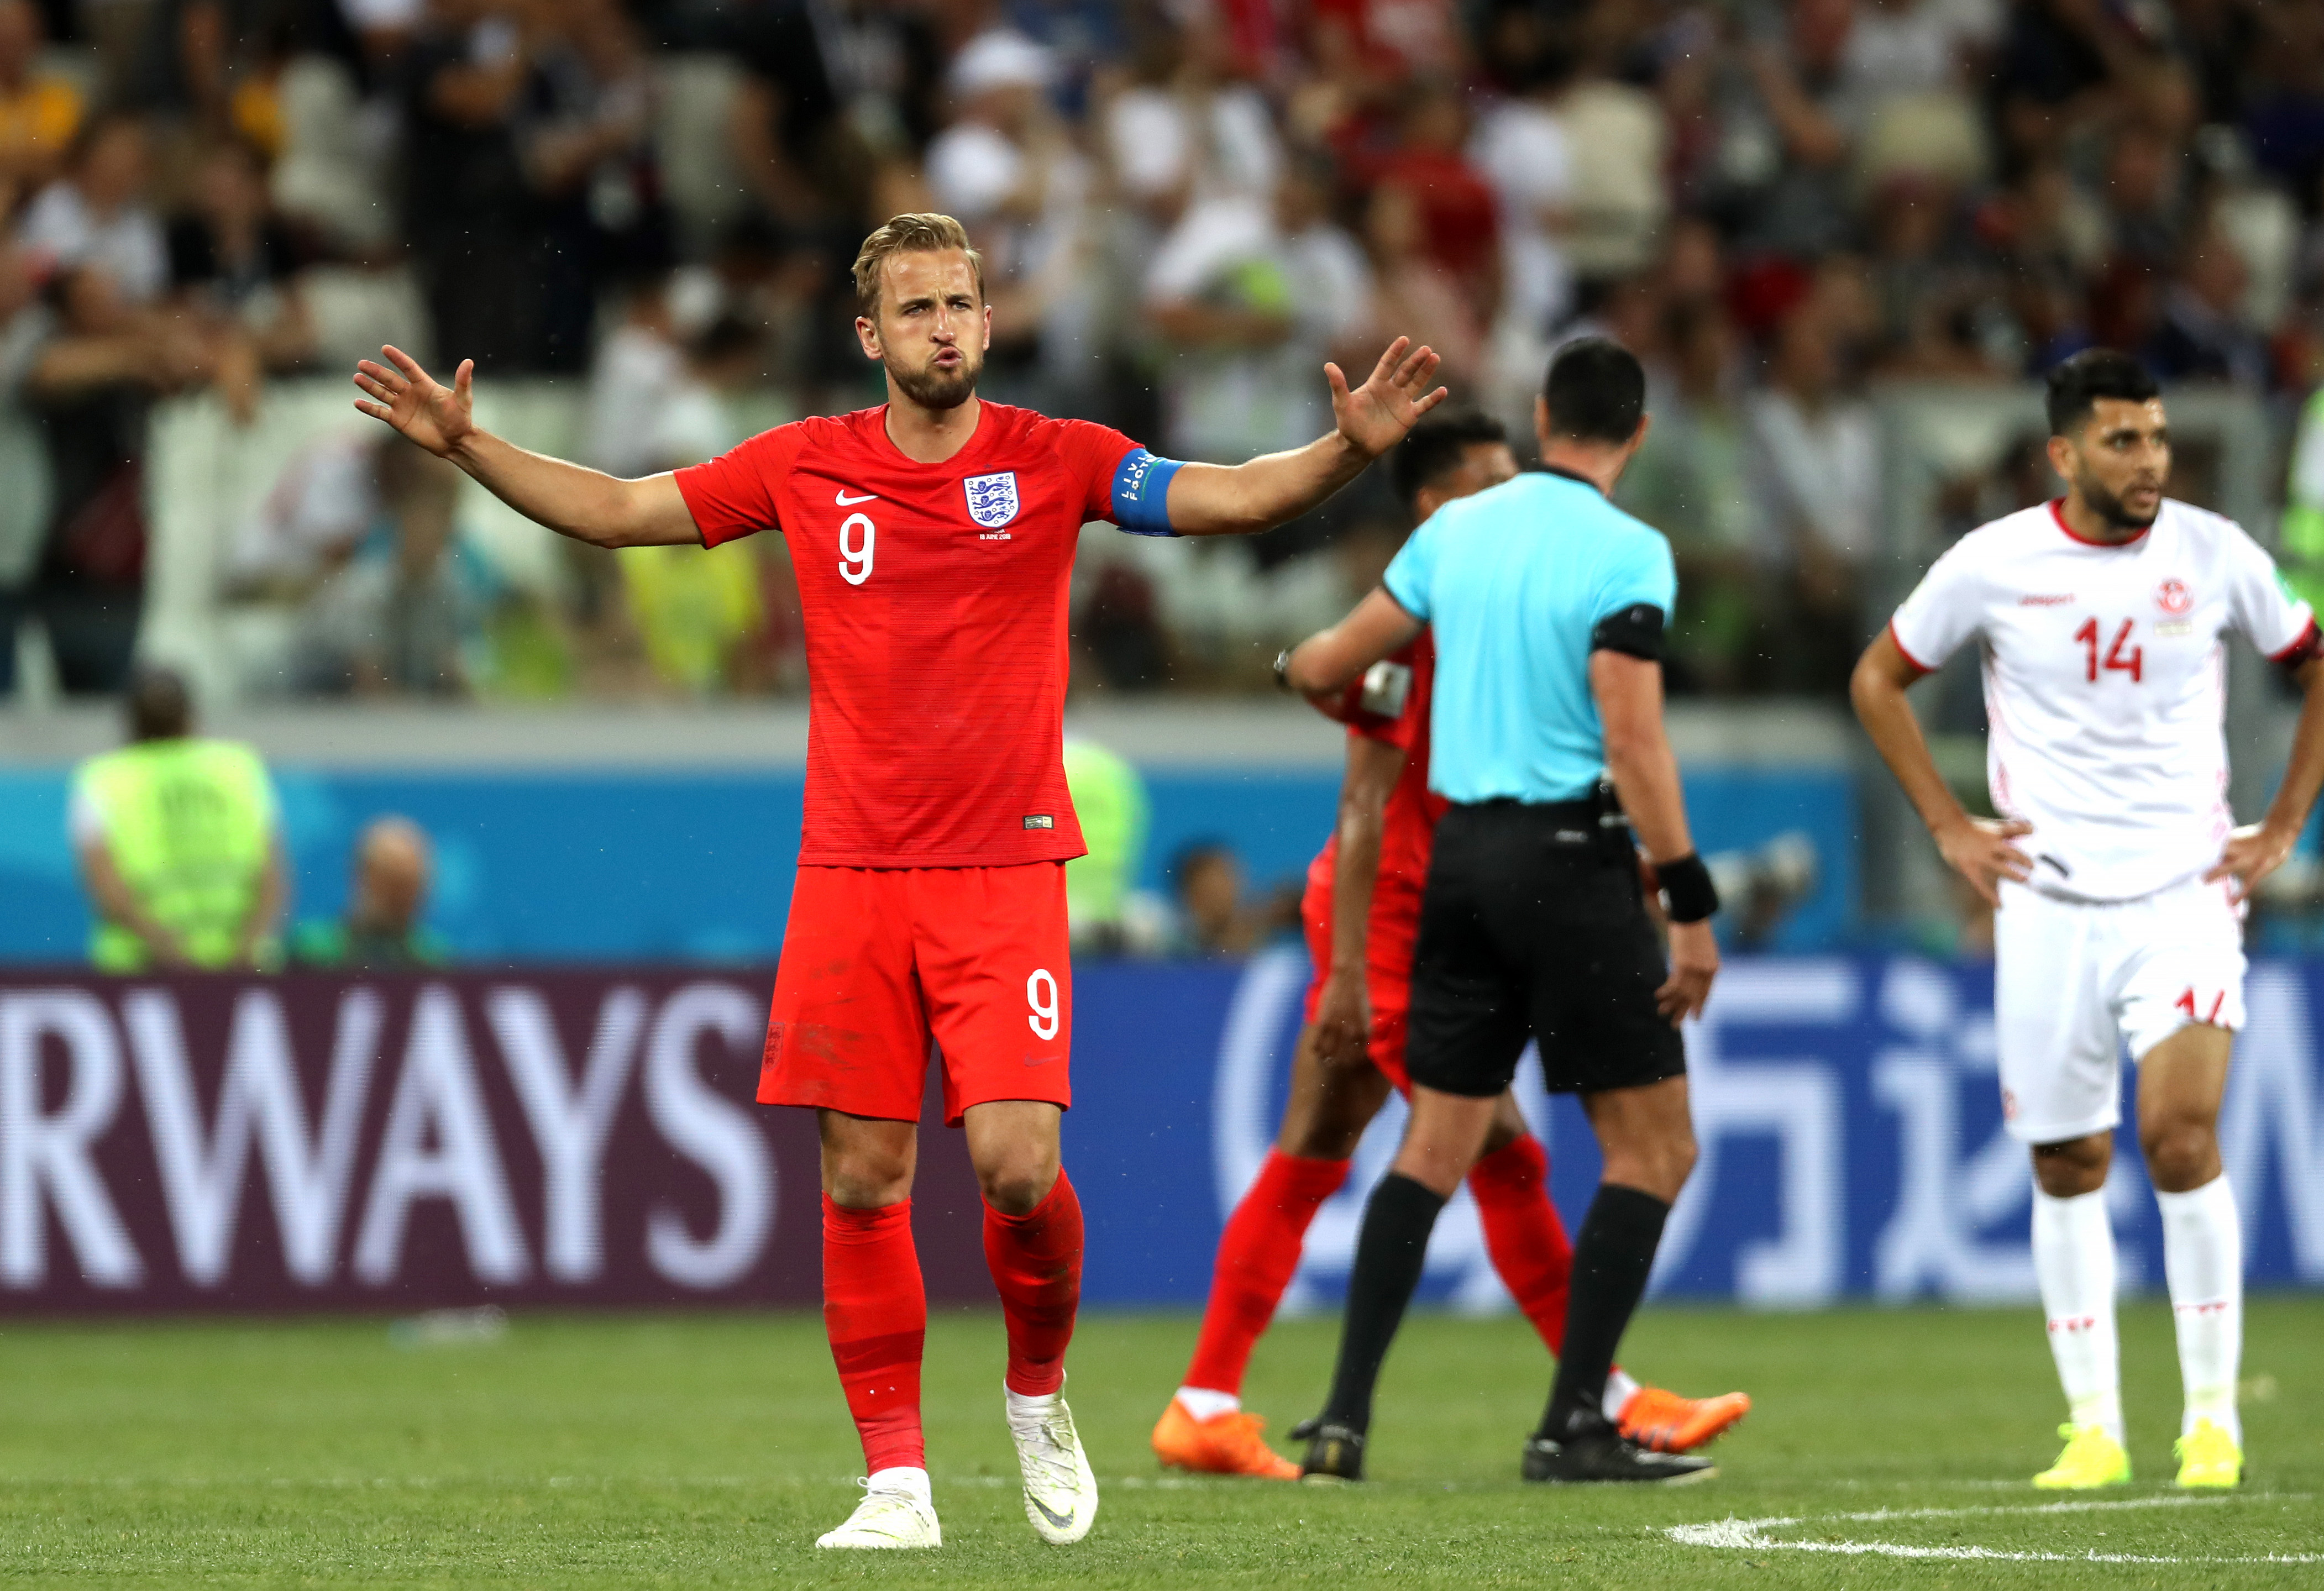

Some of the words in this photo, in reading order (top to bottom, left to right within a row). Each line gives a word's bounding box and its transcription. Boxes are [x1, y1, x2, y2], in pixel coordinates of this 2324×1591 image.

[838, 513, 875, 585] 9
[2074, 616, 2142, 683] 14
[1026, 968, 1059, 1041] 9
[0, 980, 778, 1291] RWAYS
